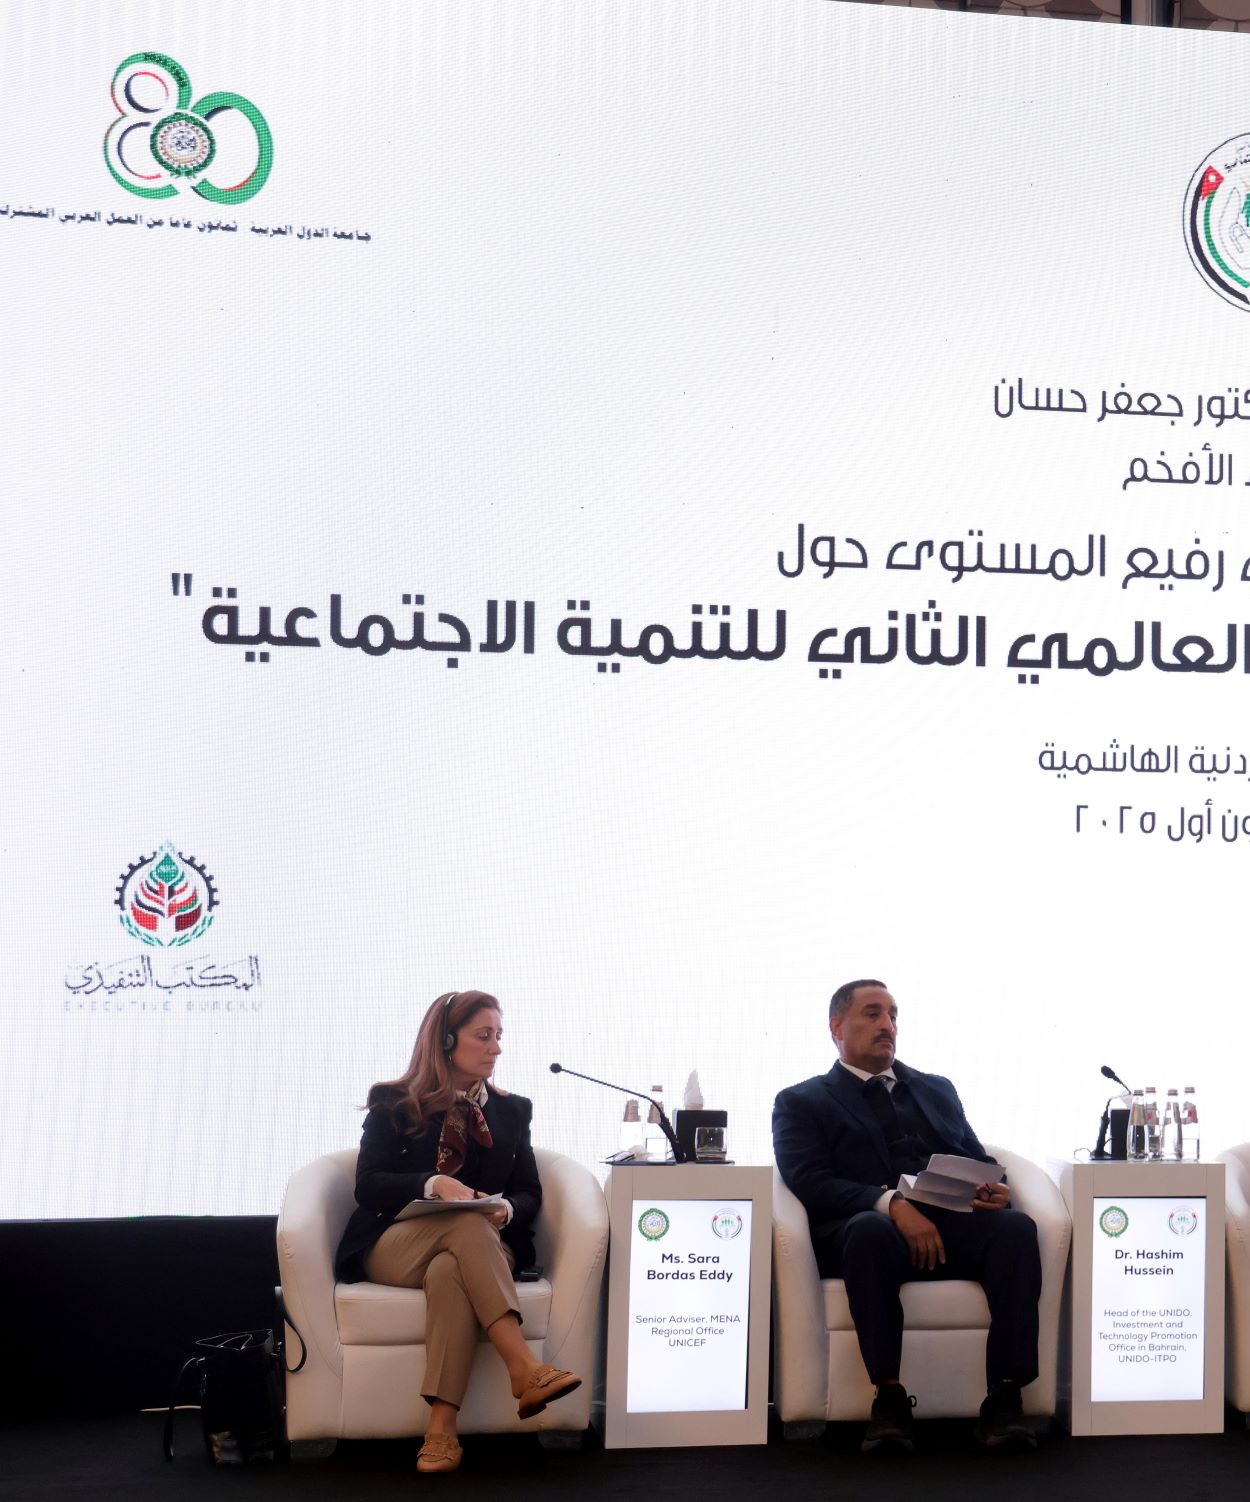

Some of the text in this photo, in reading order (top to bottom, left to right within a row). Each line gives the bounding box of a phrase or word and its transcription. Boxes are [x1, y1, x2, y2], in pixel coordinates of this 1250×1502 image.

[250, 223, 293, 238] العربية
[296, 225, 329, 241] الدول
[332, 229, 372, 242] جامعة
[995, 378, 1087, 418] حسان
[1097, 383, 1183, 426] جعفر
[1123, 443, 1232, 490] الأفخم
[778, 524, 868, 579] حول
[886, 530, 1105, 583] المستوى
[1122, 538, 1224, 592] رفيع
[557, 600, 786, 673] للتنمية
[808, 600, 986, 679] الثاني
[1039, 739, 1178, 778] الهاشمية
[1168, 799, 1212, 843] أول
[65, 955, 260, 995] المكتب التنفيذي
[661, 1253, 720, 1264] Ms. Sara
[1115, 1249, 1184, 1260] Dr. Hashim
[647, 1269, 733, 1283] Bordas Eddy
[1124, 1265, 1174, 1276] Hussein
[635, 1315, 667, 1324] Senior
[710, 1315, 741, 1323] MENA
[1104, 1309, 1128, 1317] Head
[1130, 1309, 1140, 1317] of
[1142, 1309, 1157, 1317] the
[1112, 1320, 1183, 1329] Investment and
[651, 1327, 725, 1338] Regional Office
[1098, 1332, 1198, 1342] Technology Promotion
[668, 1339, 706, 1347] UNICEF
[1108, 1343, 1136, 1352] Office
[1138, 1343, 1146, 1352] in
[1118, 1354, 1177, 1363] UNIDO-ITPO
